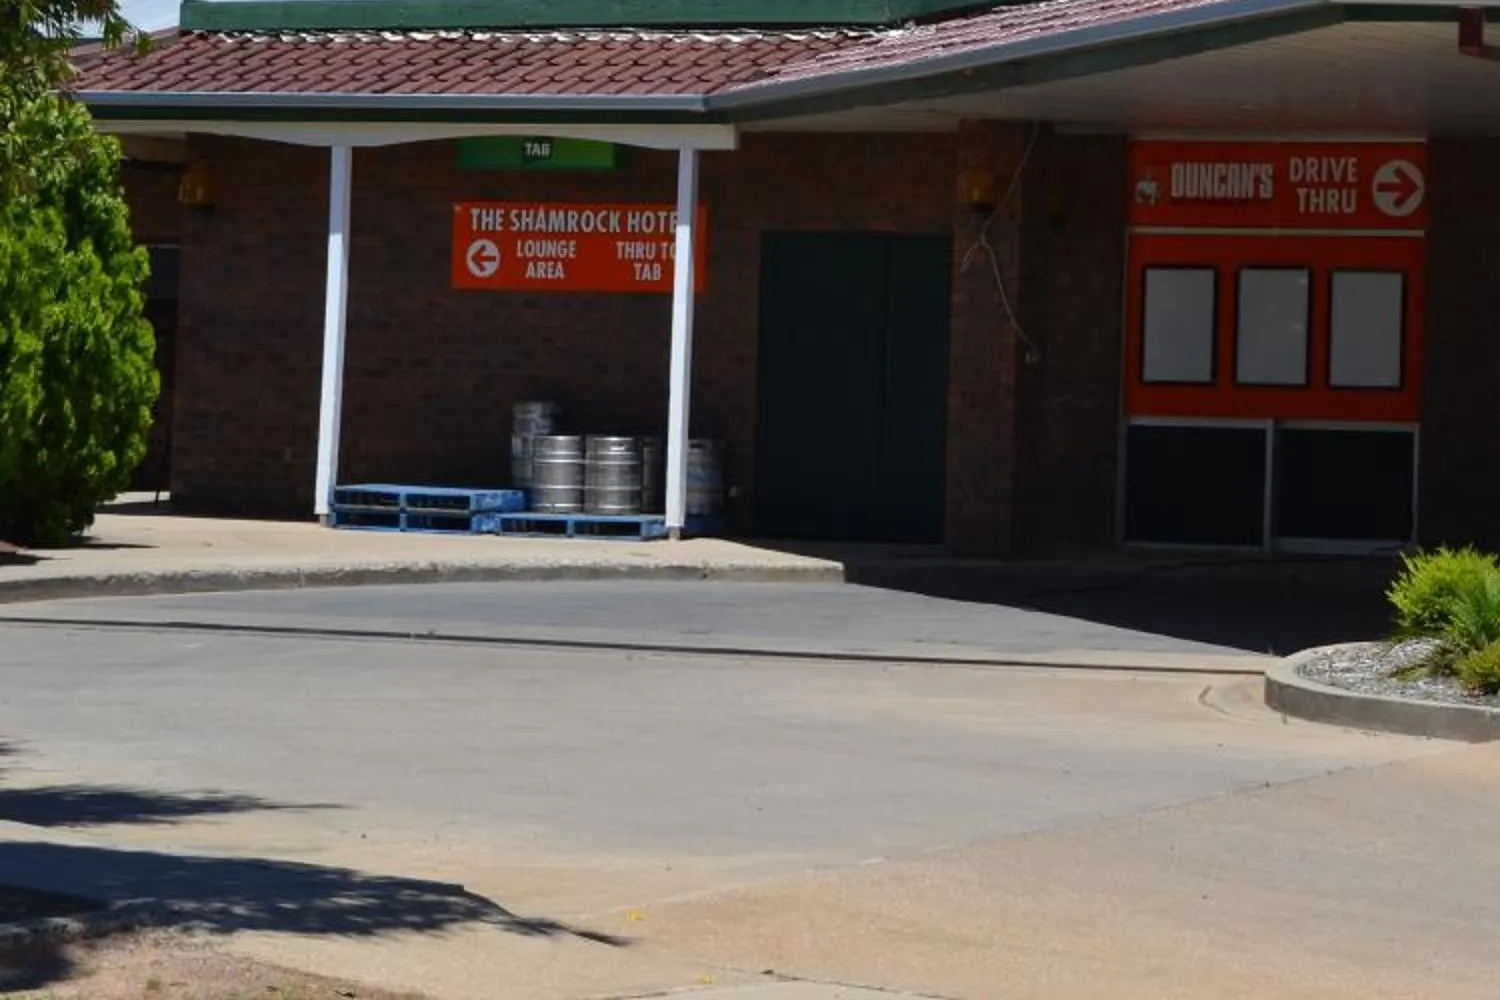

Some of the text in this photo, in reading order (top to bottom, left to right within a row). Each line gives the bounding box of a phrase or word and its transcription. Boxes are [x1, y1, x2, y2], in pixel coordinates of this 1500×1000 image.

[525, 143, 550, 156] TAB
[1289, 157, 1358, 183] DRIVE
[1171, 162, 1273, 199] DUNCAN'S
[1296, 188, 1357, 214] THRU
[469, 207, 678, 234] THE SHAMROCK HOTE
[516, 239, 577, 259] LOUNGE
[616, 241, 657, 261] THRU
[525, 261, 565, 280] AREA
[633, 262, 662, 281] TAB
